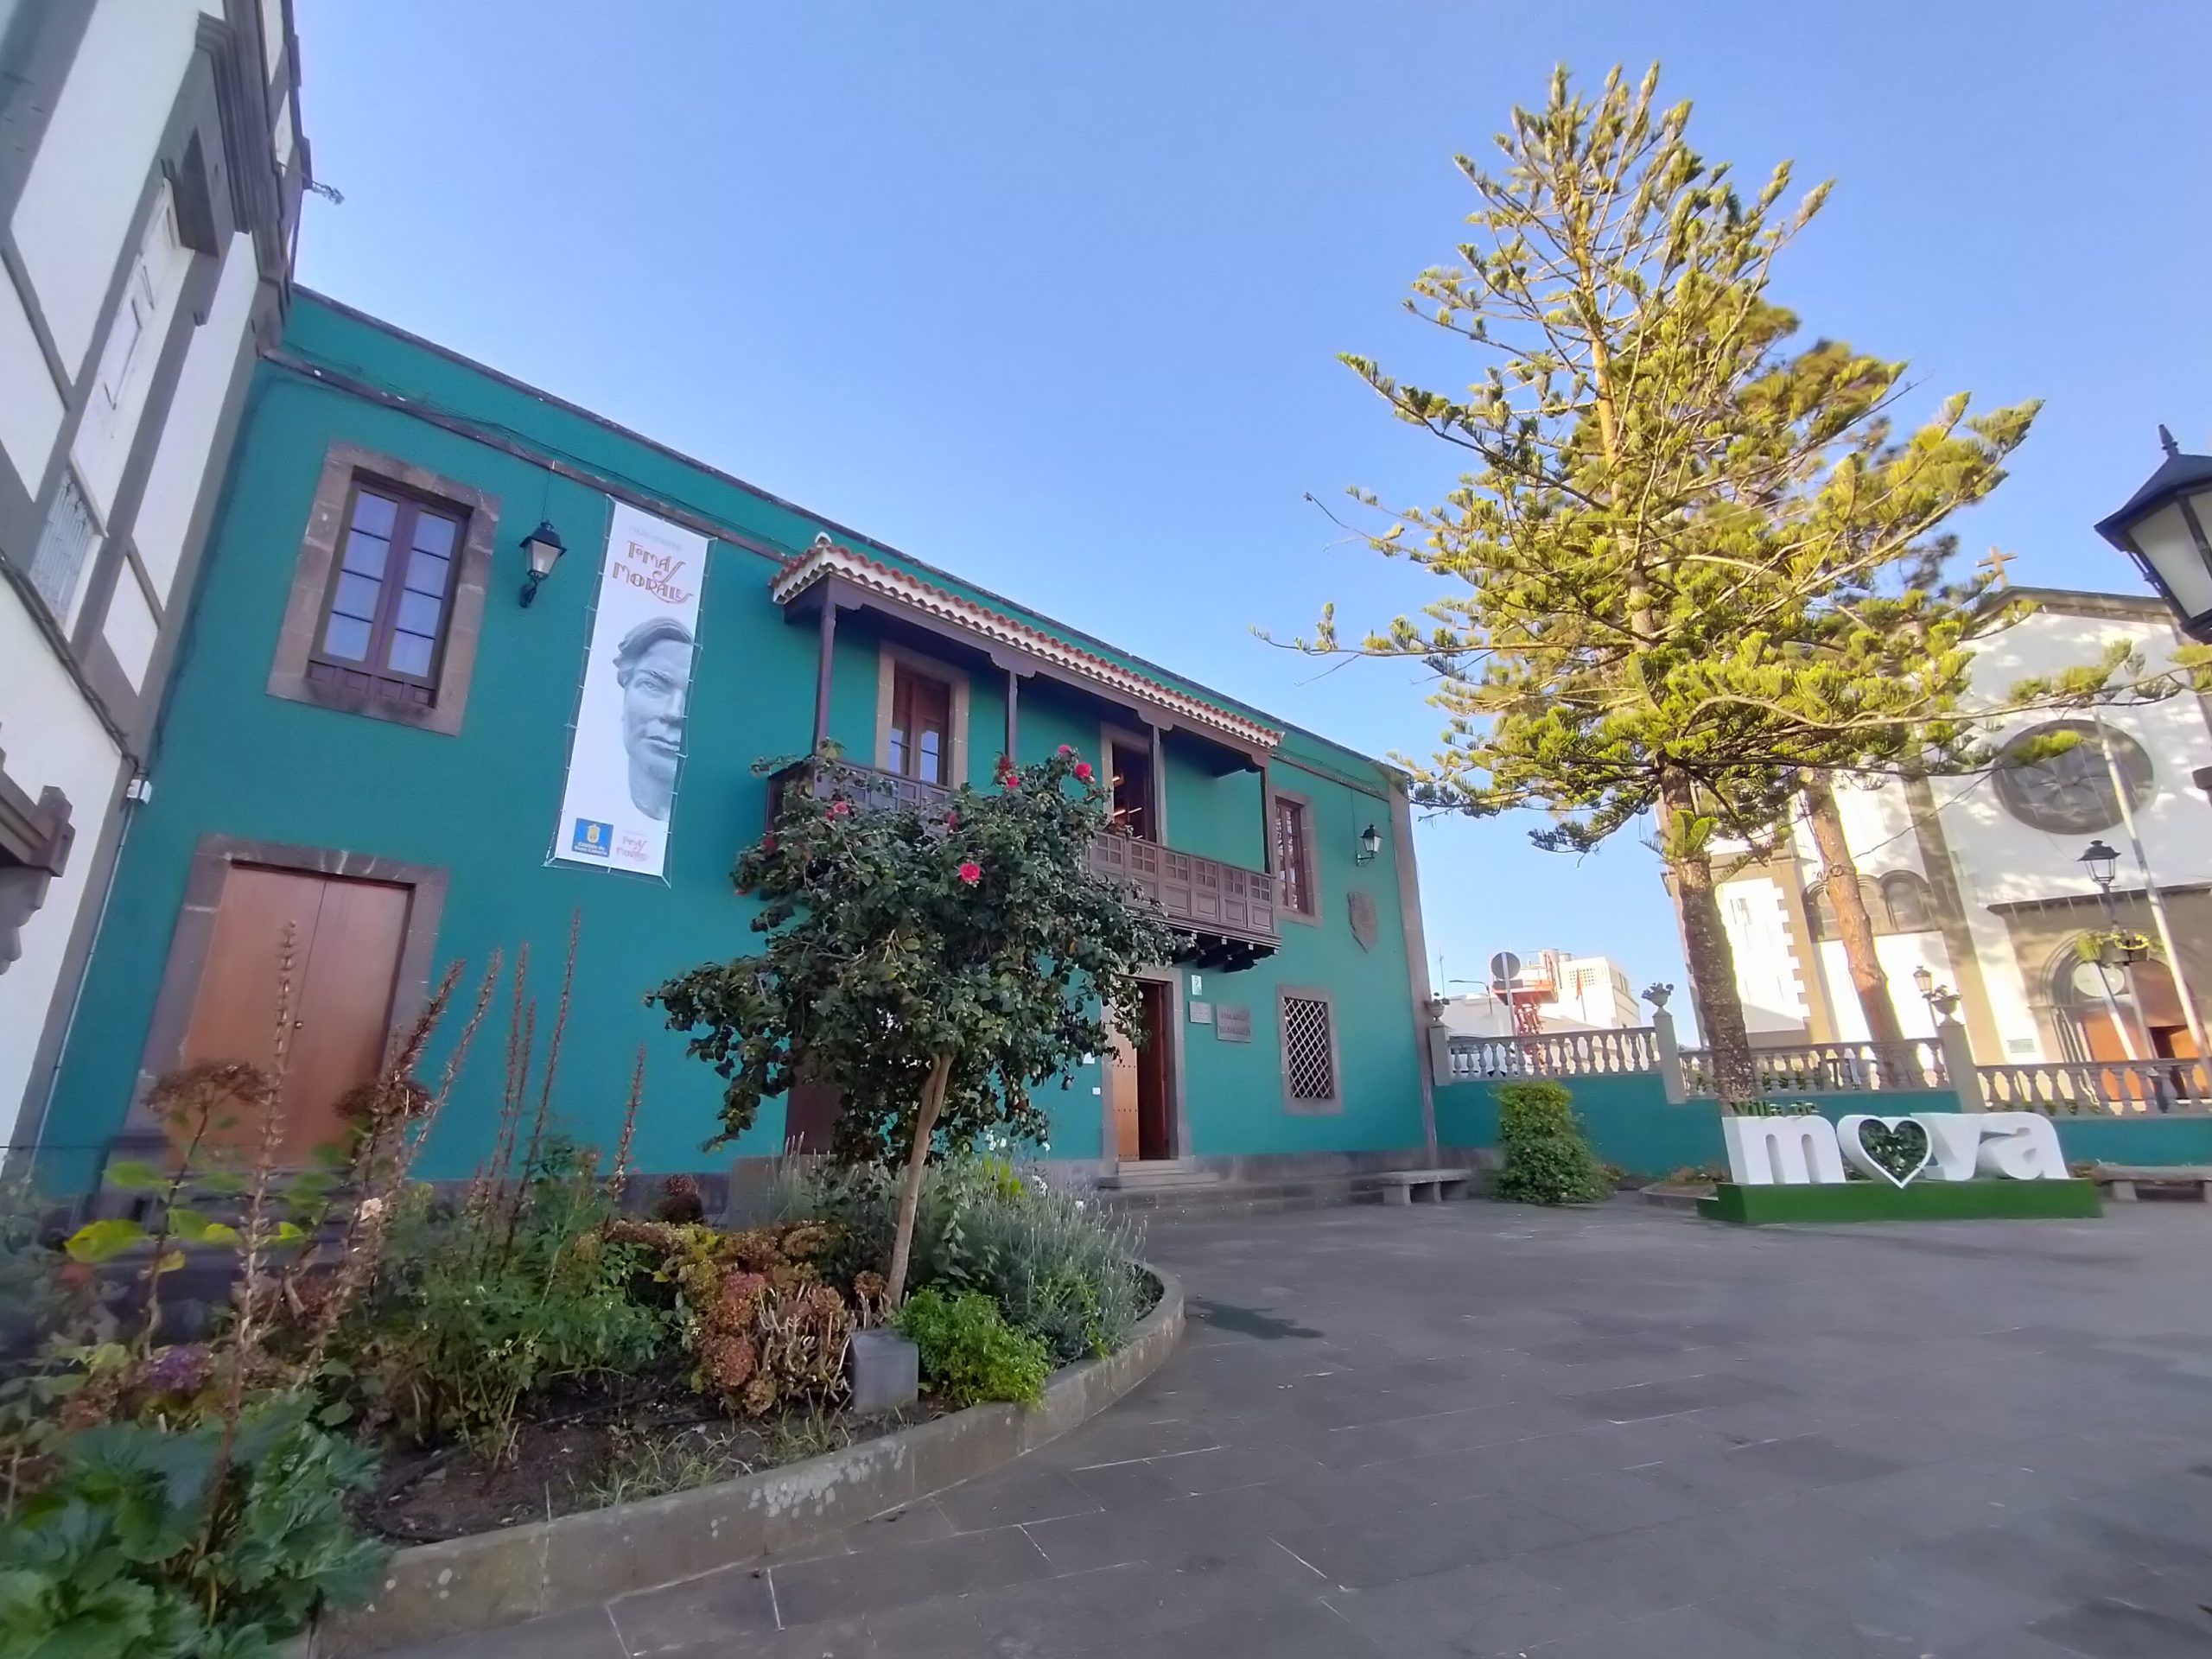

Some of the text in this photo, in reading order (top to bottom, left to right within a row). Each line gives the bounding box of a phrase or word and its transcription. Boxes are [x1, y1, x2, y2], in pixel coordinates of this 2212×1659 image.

[612, 561, 694, 604] MORALES
[1730, 1100, 1820, 1116] Villa de
